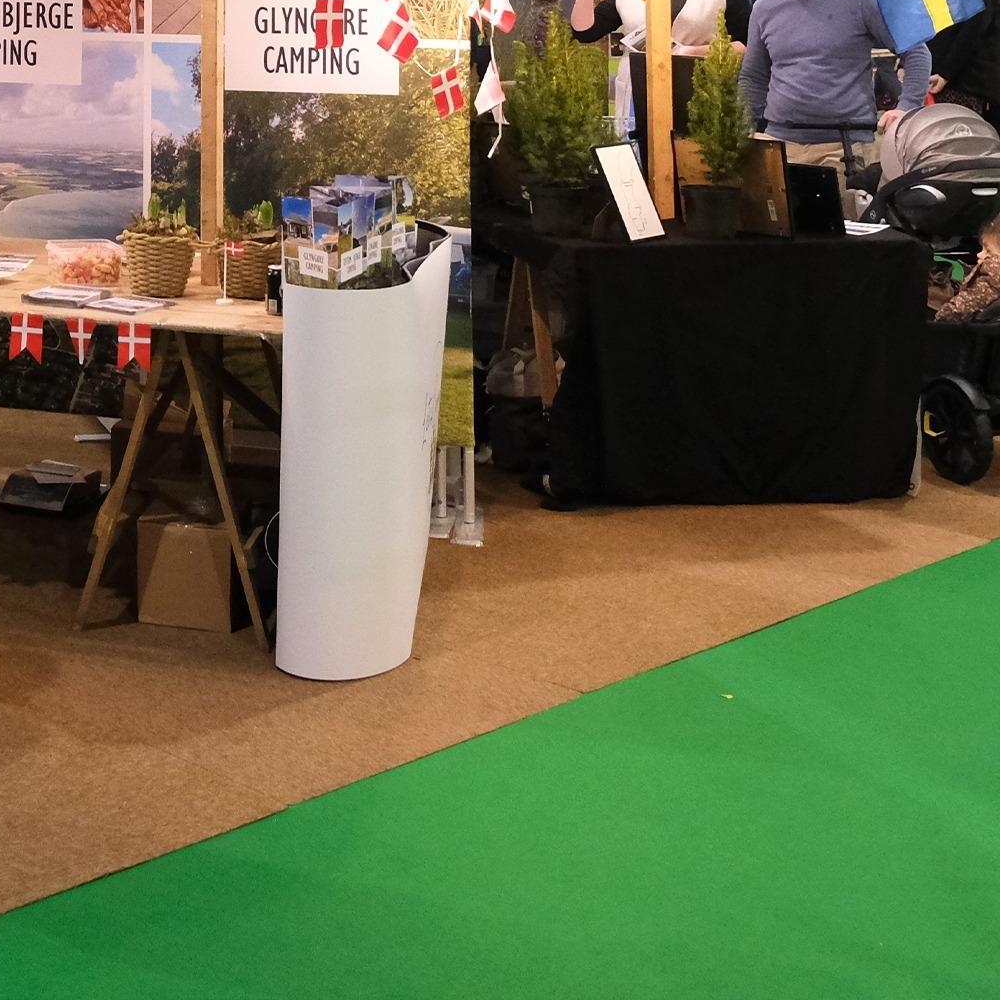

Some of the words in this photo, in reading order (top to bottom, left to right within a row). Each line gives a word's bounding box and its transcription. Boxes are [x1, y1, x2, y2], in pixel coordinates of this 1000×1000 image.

[2, 1, 74, 35] BJERGE
[254, 6, 368, 36] GLYNRE
[263, 46, 360, 76] CAMPING
